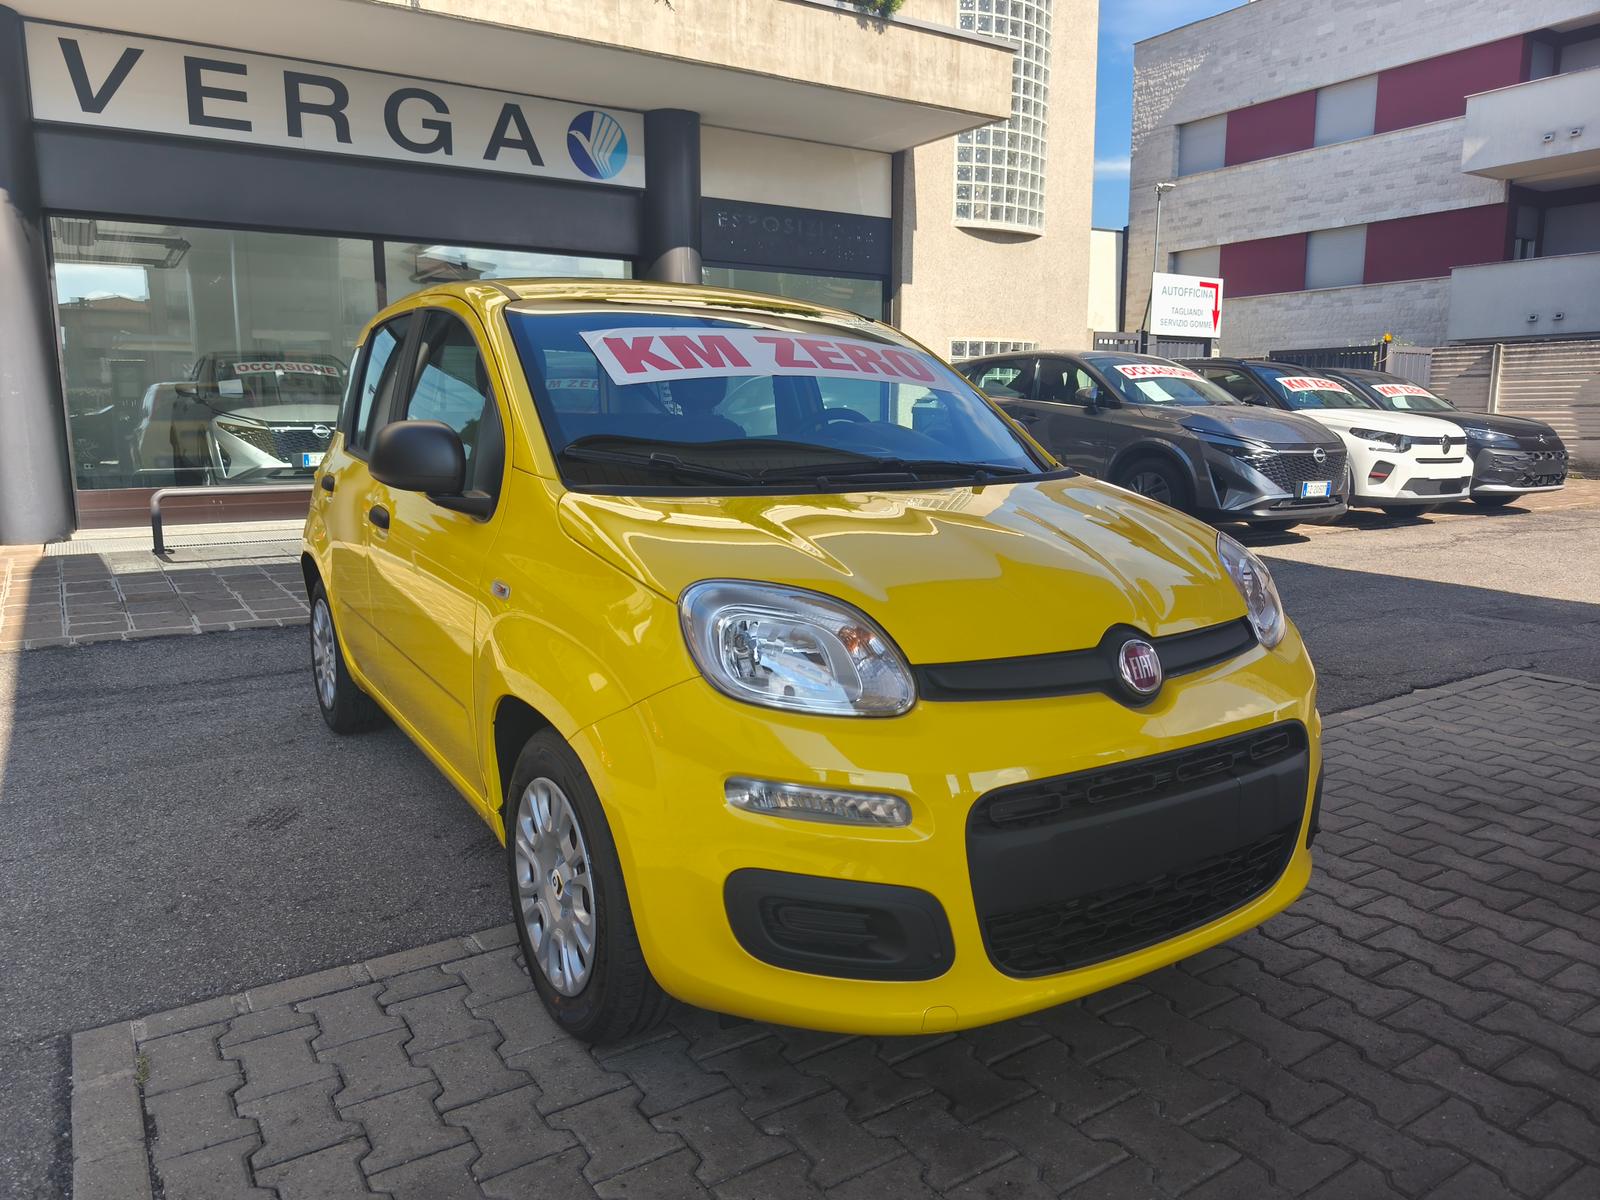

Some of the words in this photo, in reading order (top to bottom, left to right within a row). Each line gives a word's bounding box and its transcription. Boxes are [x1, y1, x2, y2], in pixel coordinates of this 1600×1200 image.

[57, 37, 546, 168] VERGA
[1161, 285, 1214, 299] AUTOFFICINA
[1171, 306, 1203, 317] TAGLIANDI
[1159, 317, 1188, 328] SERVIZIO
[1189, 319, 1213, 329] GOMME
[602, 334, 752, 374] KM
[759, 335, 937, 383] ZERO
[237, 362, 337, 376] OCCASIONE
[1283, 378, 1312, 389] KM
[1377, 385, 1402, 396] KM
[1128, 655, 1154, 680] FIAT
